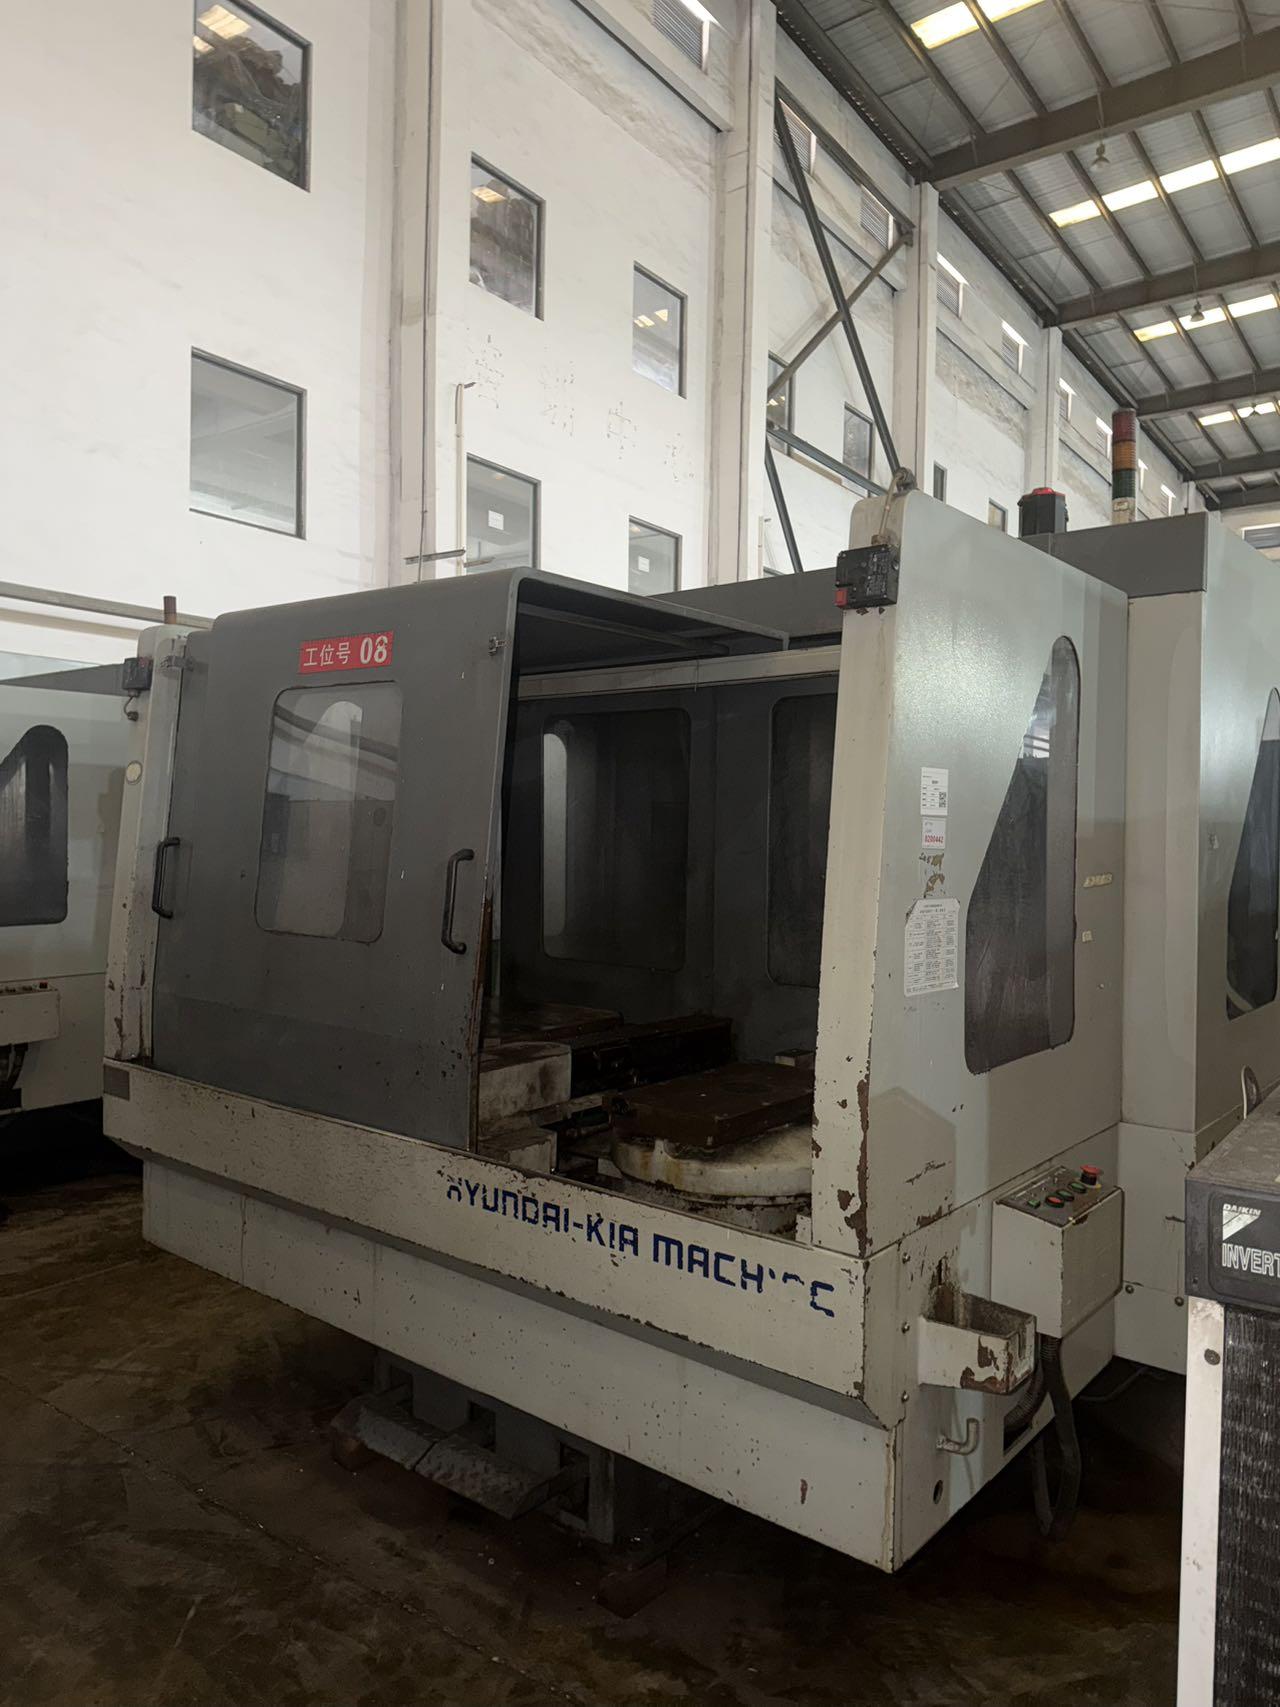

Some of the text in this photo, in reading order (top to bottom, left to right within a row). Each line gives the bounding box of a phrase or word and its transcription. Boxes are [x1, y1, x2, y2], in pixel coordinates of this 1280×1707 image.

[303, 641, 351, 666] 工位号
[1222, 1203, 1261, 1216] DAIKIN
